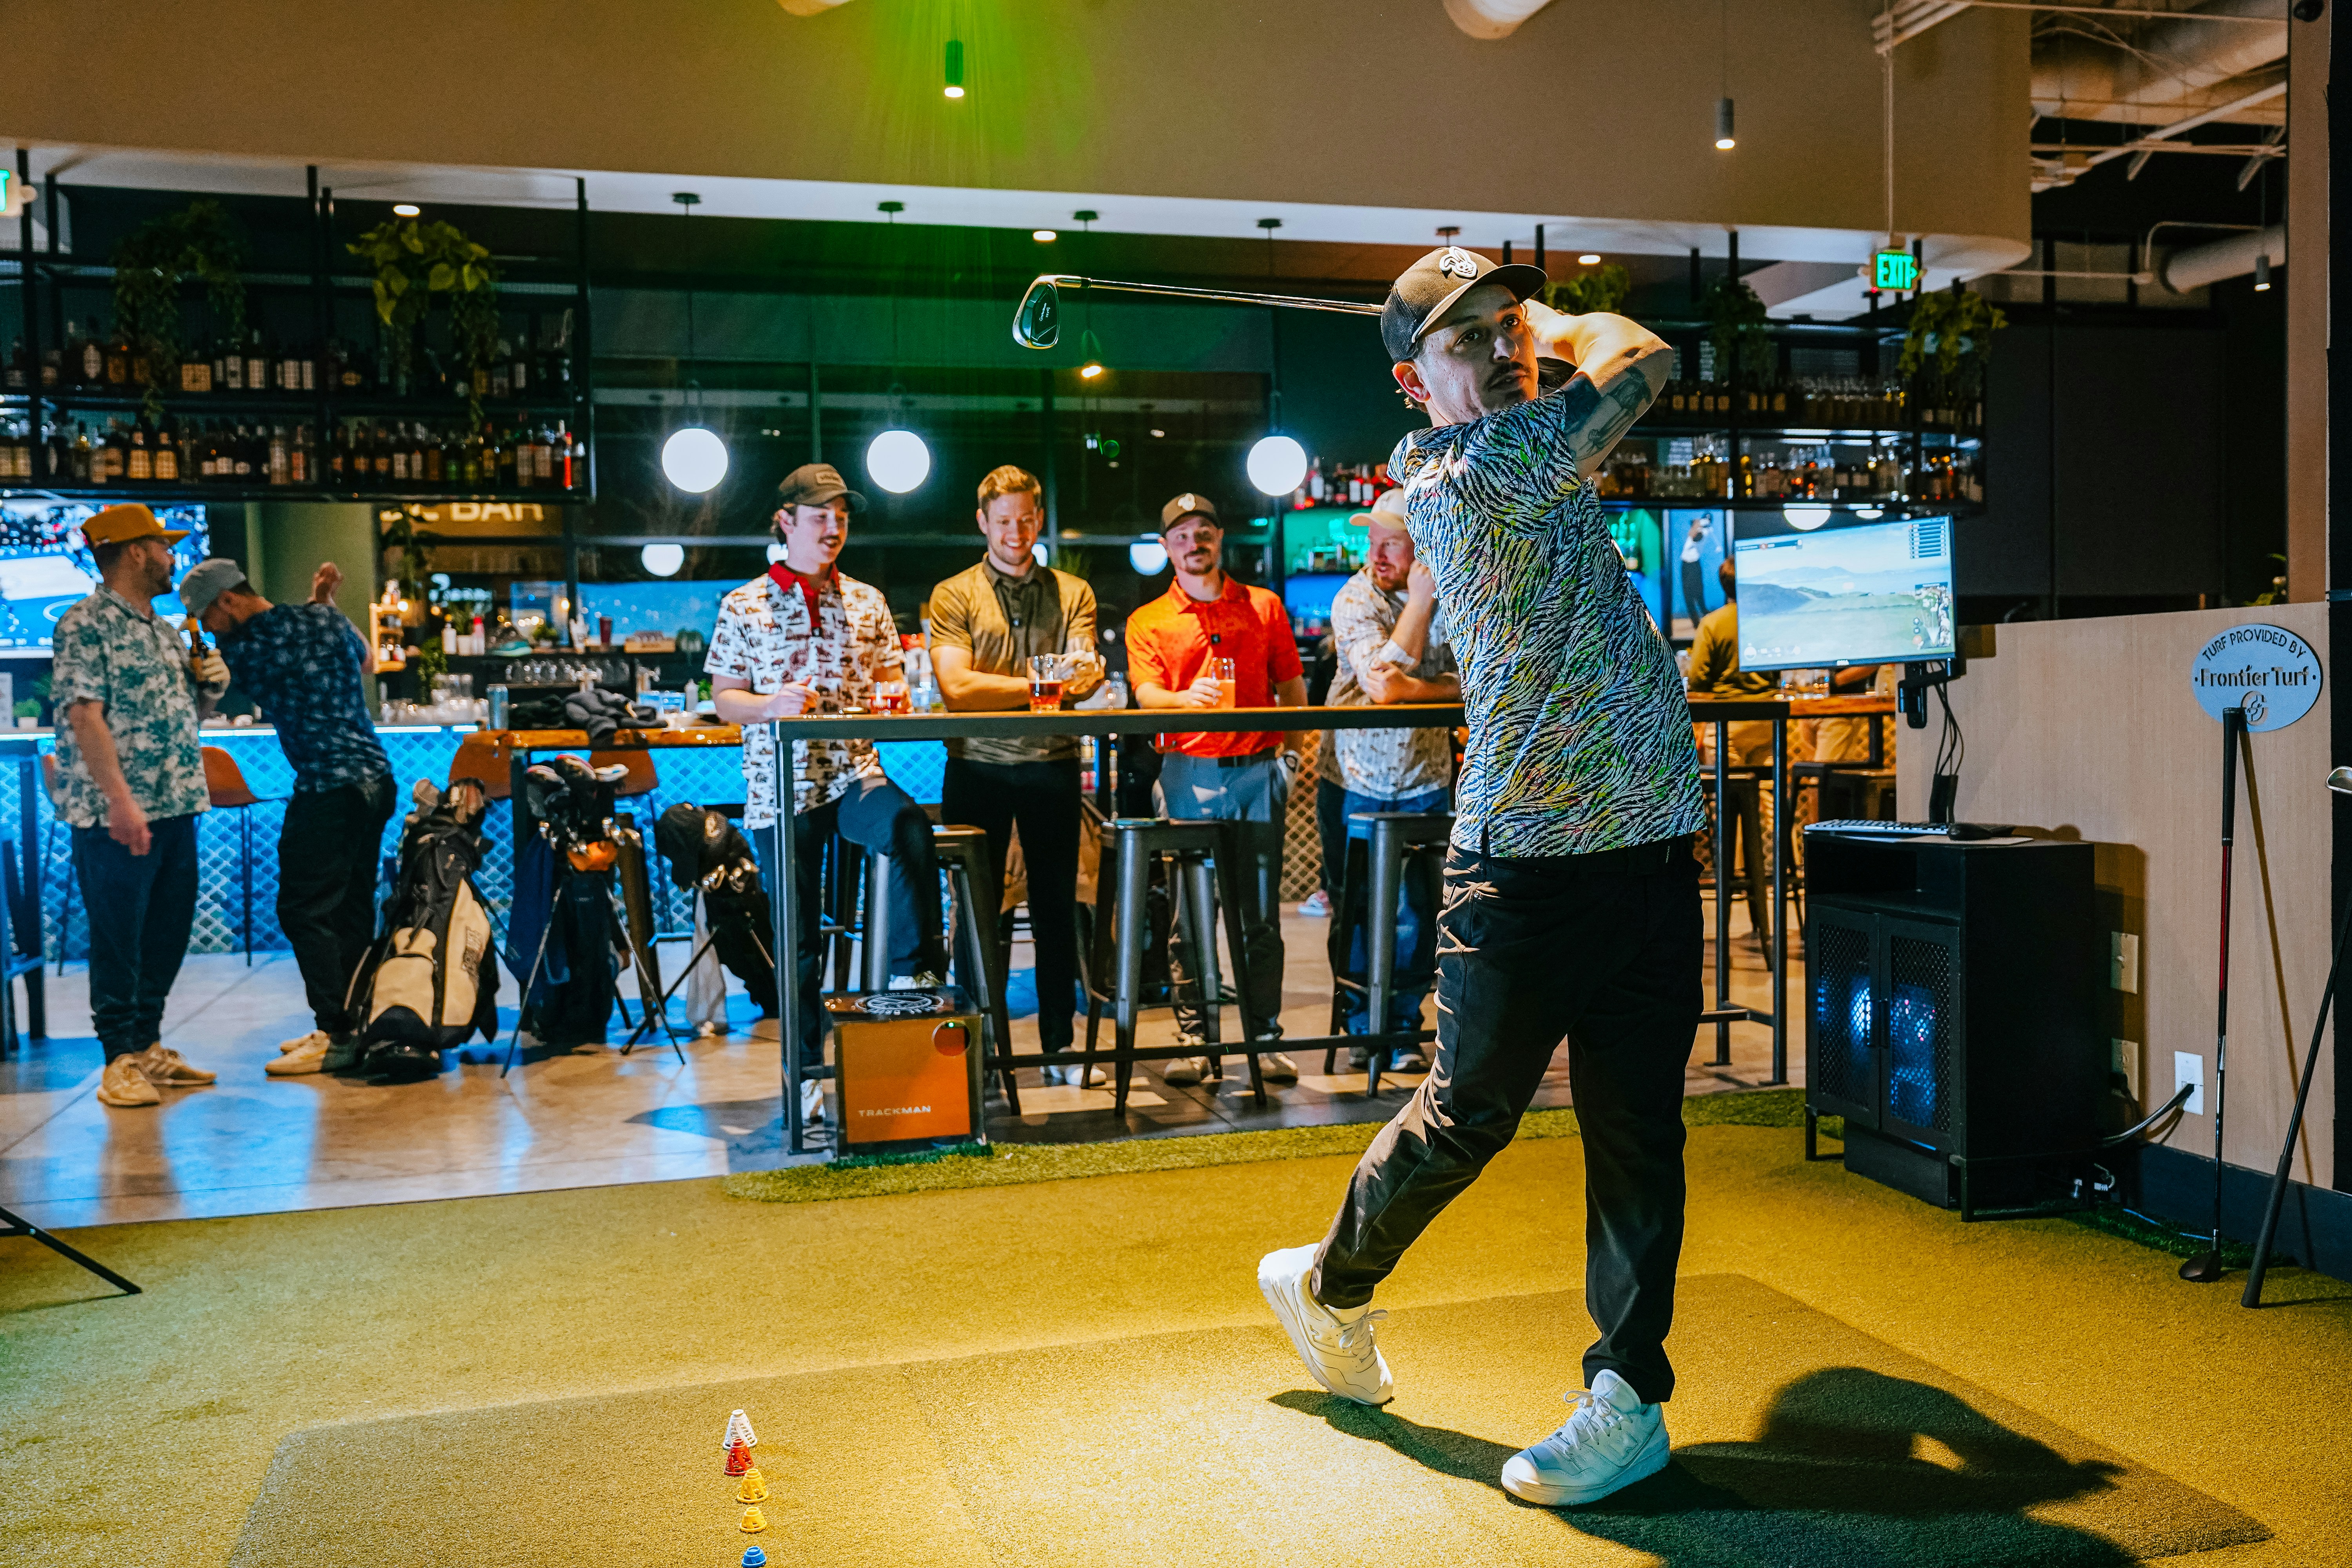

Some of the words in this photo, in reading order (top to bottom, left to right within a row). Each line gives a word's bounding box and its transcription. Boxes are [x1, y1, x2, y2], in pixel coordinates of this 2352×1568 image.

[1876, 253, 1914, 289] EXIT
[2202, 636, 2226, 661] TURF
[2229, 629, 2287, 647] PROVIDED
[2288, 640, 2306, 658] BY
[858, 1105, 931, 1117] TRACKMAN
